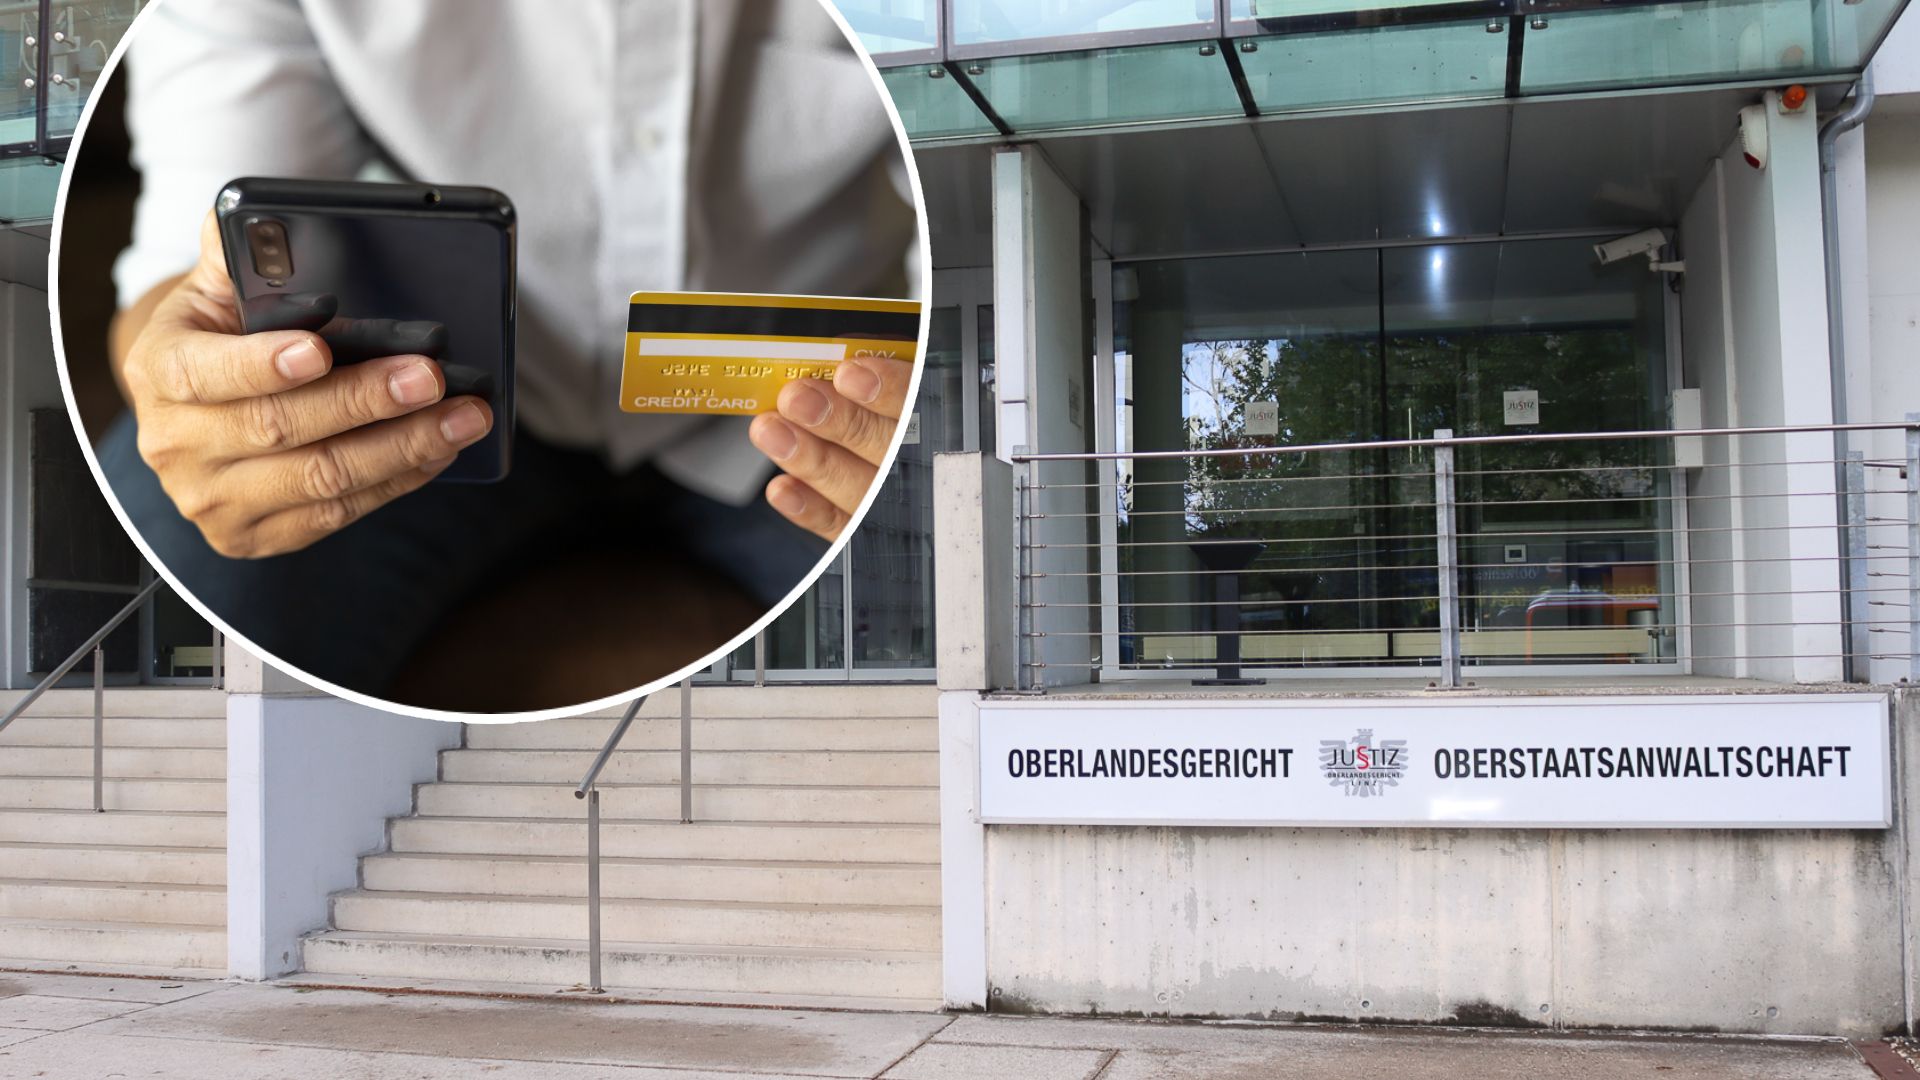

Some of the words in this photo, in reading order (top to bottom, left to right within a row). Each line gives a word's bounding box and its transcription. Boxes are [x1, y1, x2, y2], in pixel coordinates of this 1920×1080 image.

[634, 396, 702, 408] CREDIT
[706, 397, 758, 410] CARD
[1008, 748, 1293, 778] OBERLANDESGERICHT
[1434, 746, 1850, 779] OBERSTAATSANWALTSCHAFT
